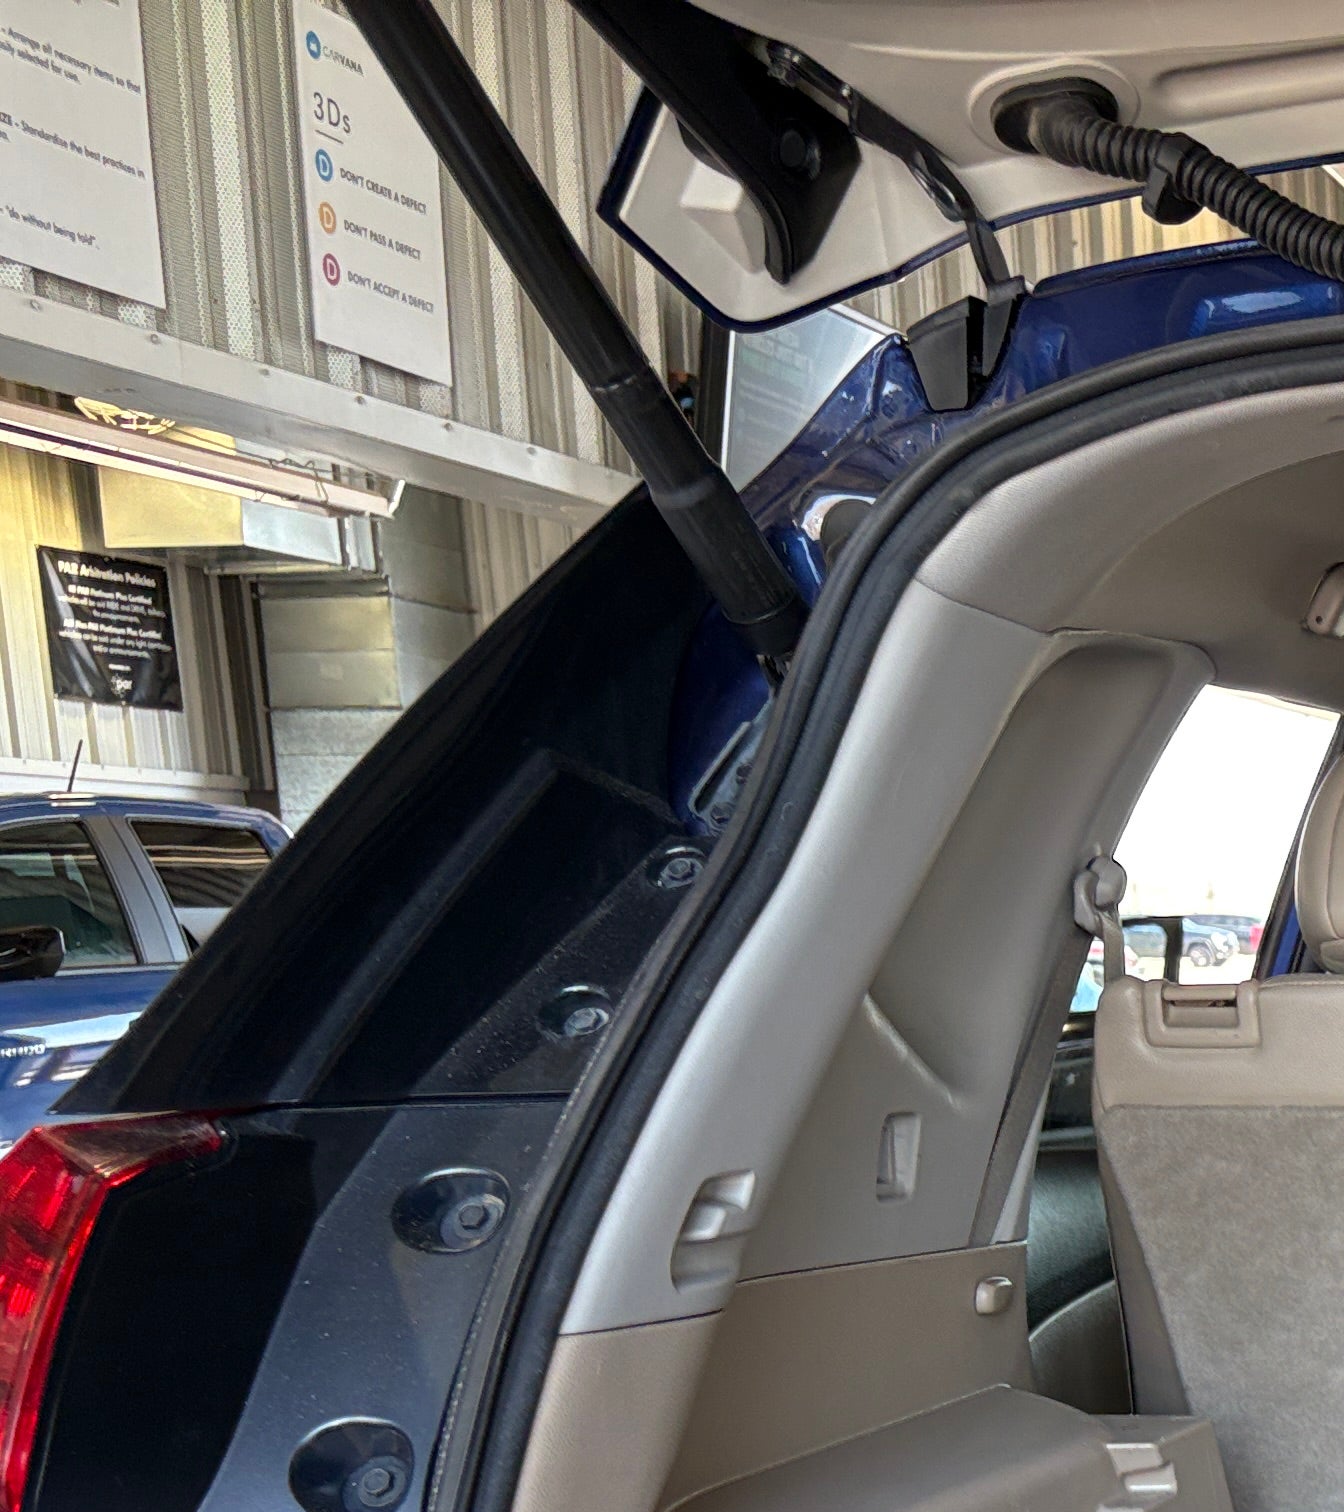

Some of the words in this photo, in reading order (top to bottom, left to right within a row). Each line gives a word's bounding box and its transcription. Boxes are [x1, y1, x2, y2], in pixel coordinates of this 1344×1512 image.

[8, 27, 40, 51] Arrange
[42, 42, 52, 54] all
[54, 49, 91, 76] necessary
[94, 65, 115, 82] items
[116, 77, 124, 86] so
[126, 80, 141, 94] that
[51, 60, 62, 73] for
[322, 46, 364, 75] CARVANA
[313, 91, 351, 134] 3Ds
[70, 141, 82, 154] the
[84, 145, 100, 161] best
[102, 155, 136, 175] practices
[340, 168, 364, 187] DON'T
[366, 179, 392, 200] CREATE
[401, 194, 427, 214] DEFECT
[21, 213, 51, 230] without
[53, 222, 76, 242] being
[344, 219, 368, 239] DON'T
[370, 230, 386, 246] PASS
[395, 241, 421, 260] DEFECT
[348, 271, 371, 289] DON'T
[373, 281, 400, 301] ACCEPT
[409, 295, 434, 313] DEFECT
